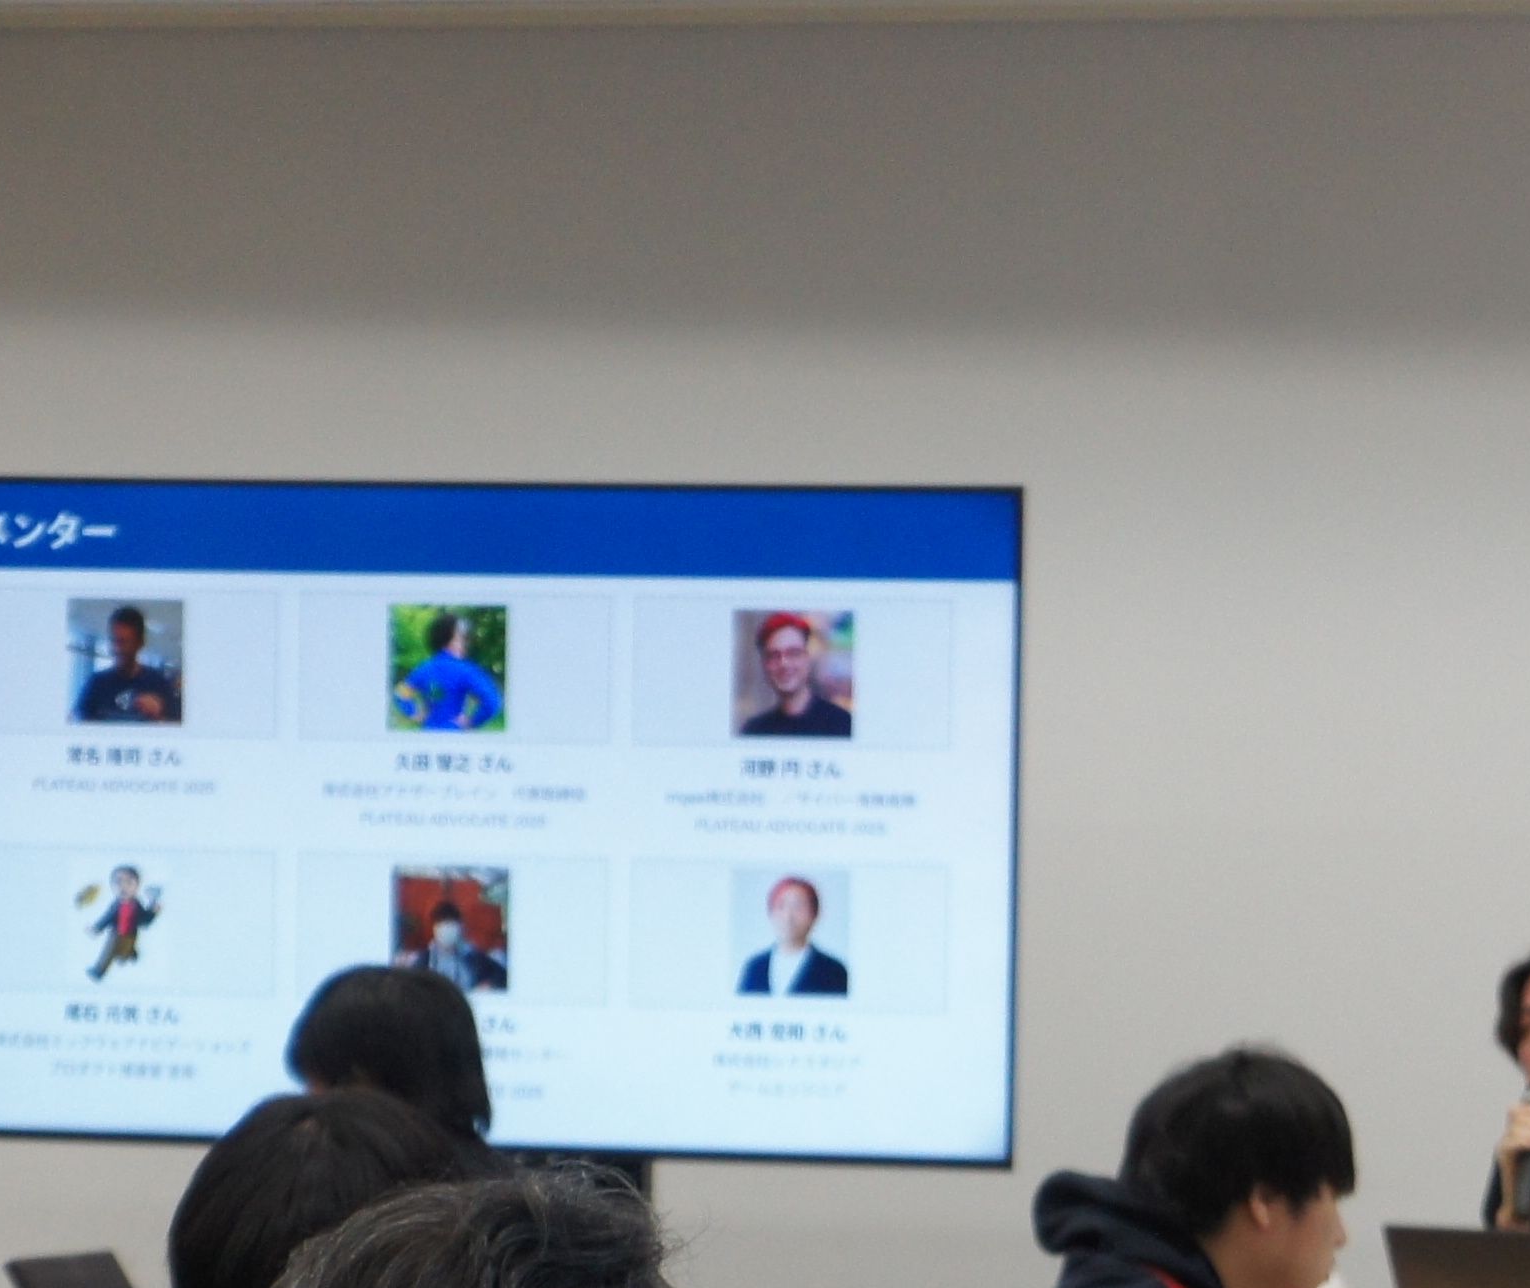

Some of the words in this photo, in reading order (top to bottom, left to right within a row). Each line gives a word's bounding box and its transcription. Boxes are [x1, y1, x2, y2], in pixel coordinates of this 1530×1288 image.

[148, 748, 183, 768] さん
[478, 754, 514, 774] さん
[806, 759, 842, 779] さん
[146, 1005, 180, 1024] さん
[811, 1023, 847, 1043] さん
